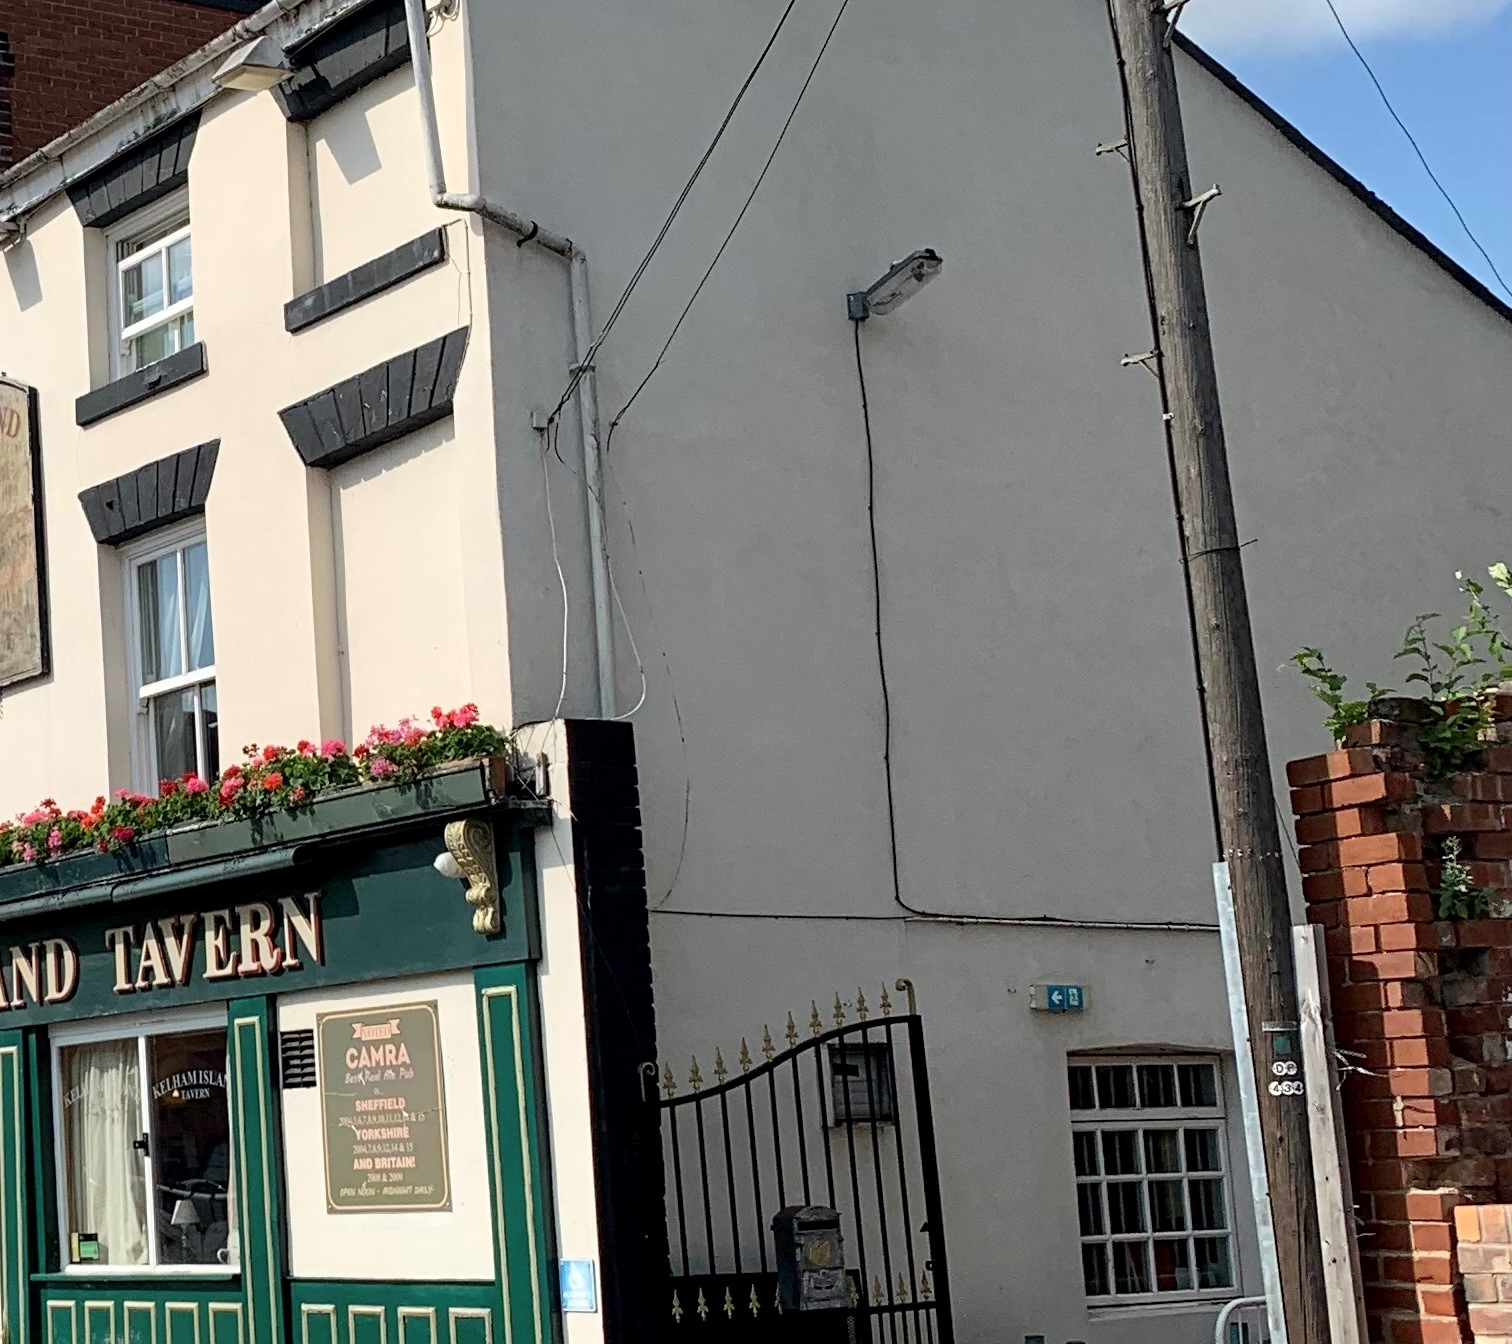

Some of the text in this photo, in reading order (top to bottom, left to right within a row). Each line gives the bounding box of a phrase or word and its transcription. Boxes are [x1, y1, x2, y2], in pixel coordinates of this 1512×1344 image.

[105, 889, 325, 994] TAVERN
[346, 1042, 411, 1069] CAMRA
[1274, 1062, 1296, 1075] DP
[152, 1069, 197, 1100] KELHAM
[199, 1069, 227, 1088] ISLA
[1271, 1082, 1303, 1094] 434
[181, 1087, 210, 1100] TAVERN
[355, 1097, 406, 1112] SHEFFIELD
[355, 1126, 410, 1141] YORKSHIRE
[353, 1156, 416, 1170] AND BRITAIN!
